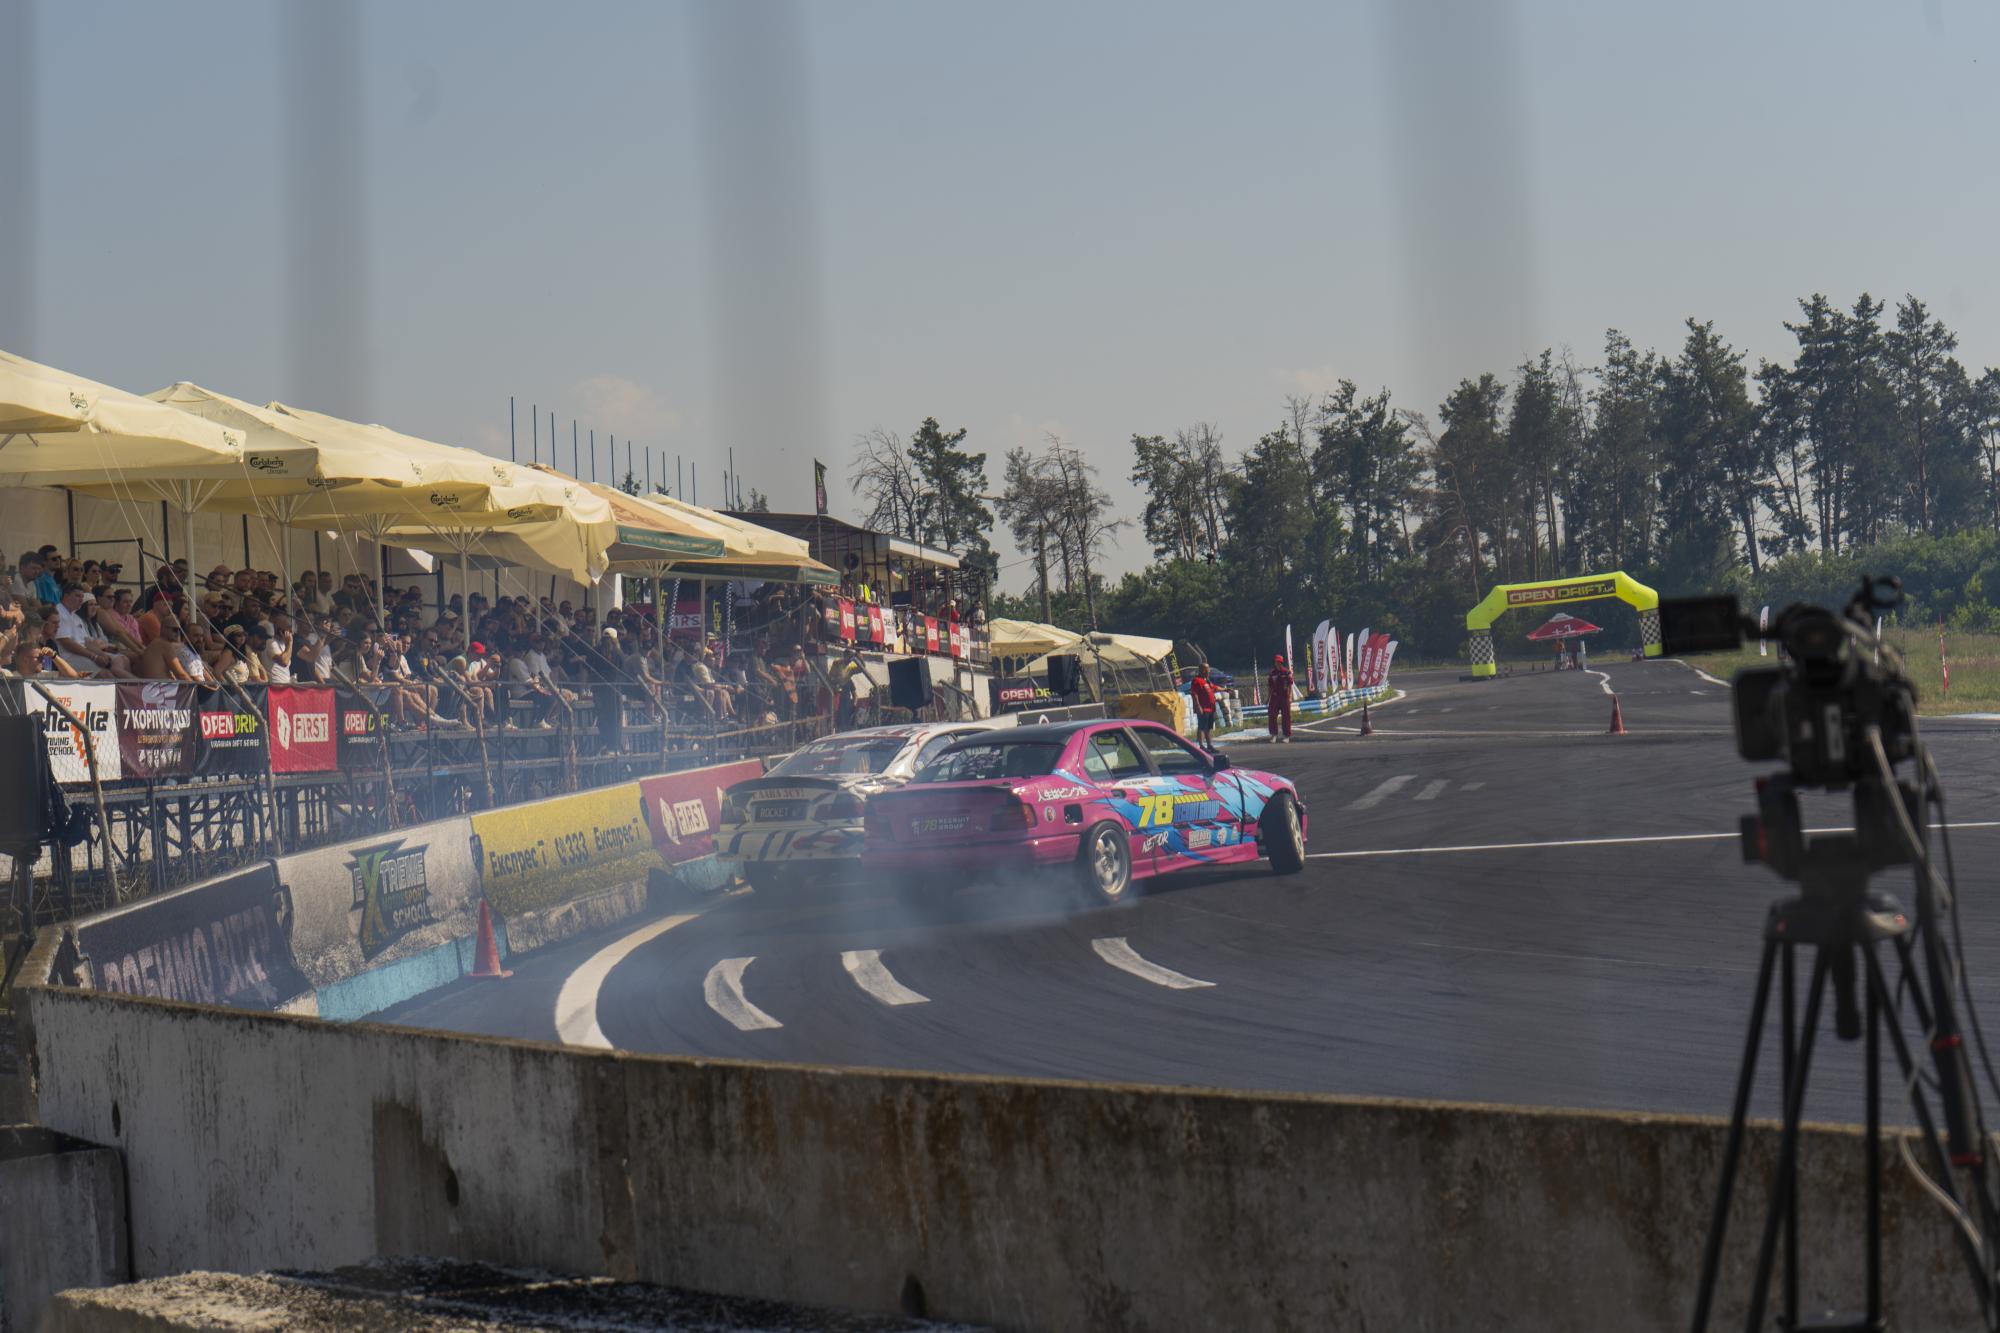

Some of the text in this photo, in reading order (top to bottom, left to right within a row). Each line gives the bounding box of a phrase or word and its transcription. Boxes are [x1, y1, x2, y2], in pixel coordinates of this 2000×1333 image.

[250, 456, 284, 470] Carlsberg
[430, 493, 459, 506] Carlsberg
[1510, 591, 1556, 603] OPEN
[673, 615, 700, 627] IRS
[1001, 689, 1033, 700] OPEN
[123, 709, 131, 729] 7
[132, 709, 170, 730] КОРПУС
[201, 713, 258, 736] OPEN DRIF
[295, 717, 327, 739] FIRST
[345, 713, 366, 731] OPEN
[677, 803, 707, 832] FIRST
[1138, 794, 1174, 828] 78
[489, 848, 538, 879] Експрес
[565, 831, 589, 864] 333
[593, 824, 634, 853] Експрес
[393, 901, 429, 928] SCHOOL
